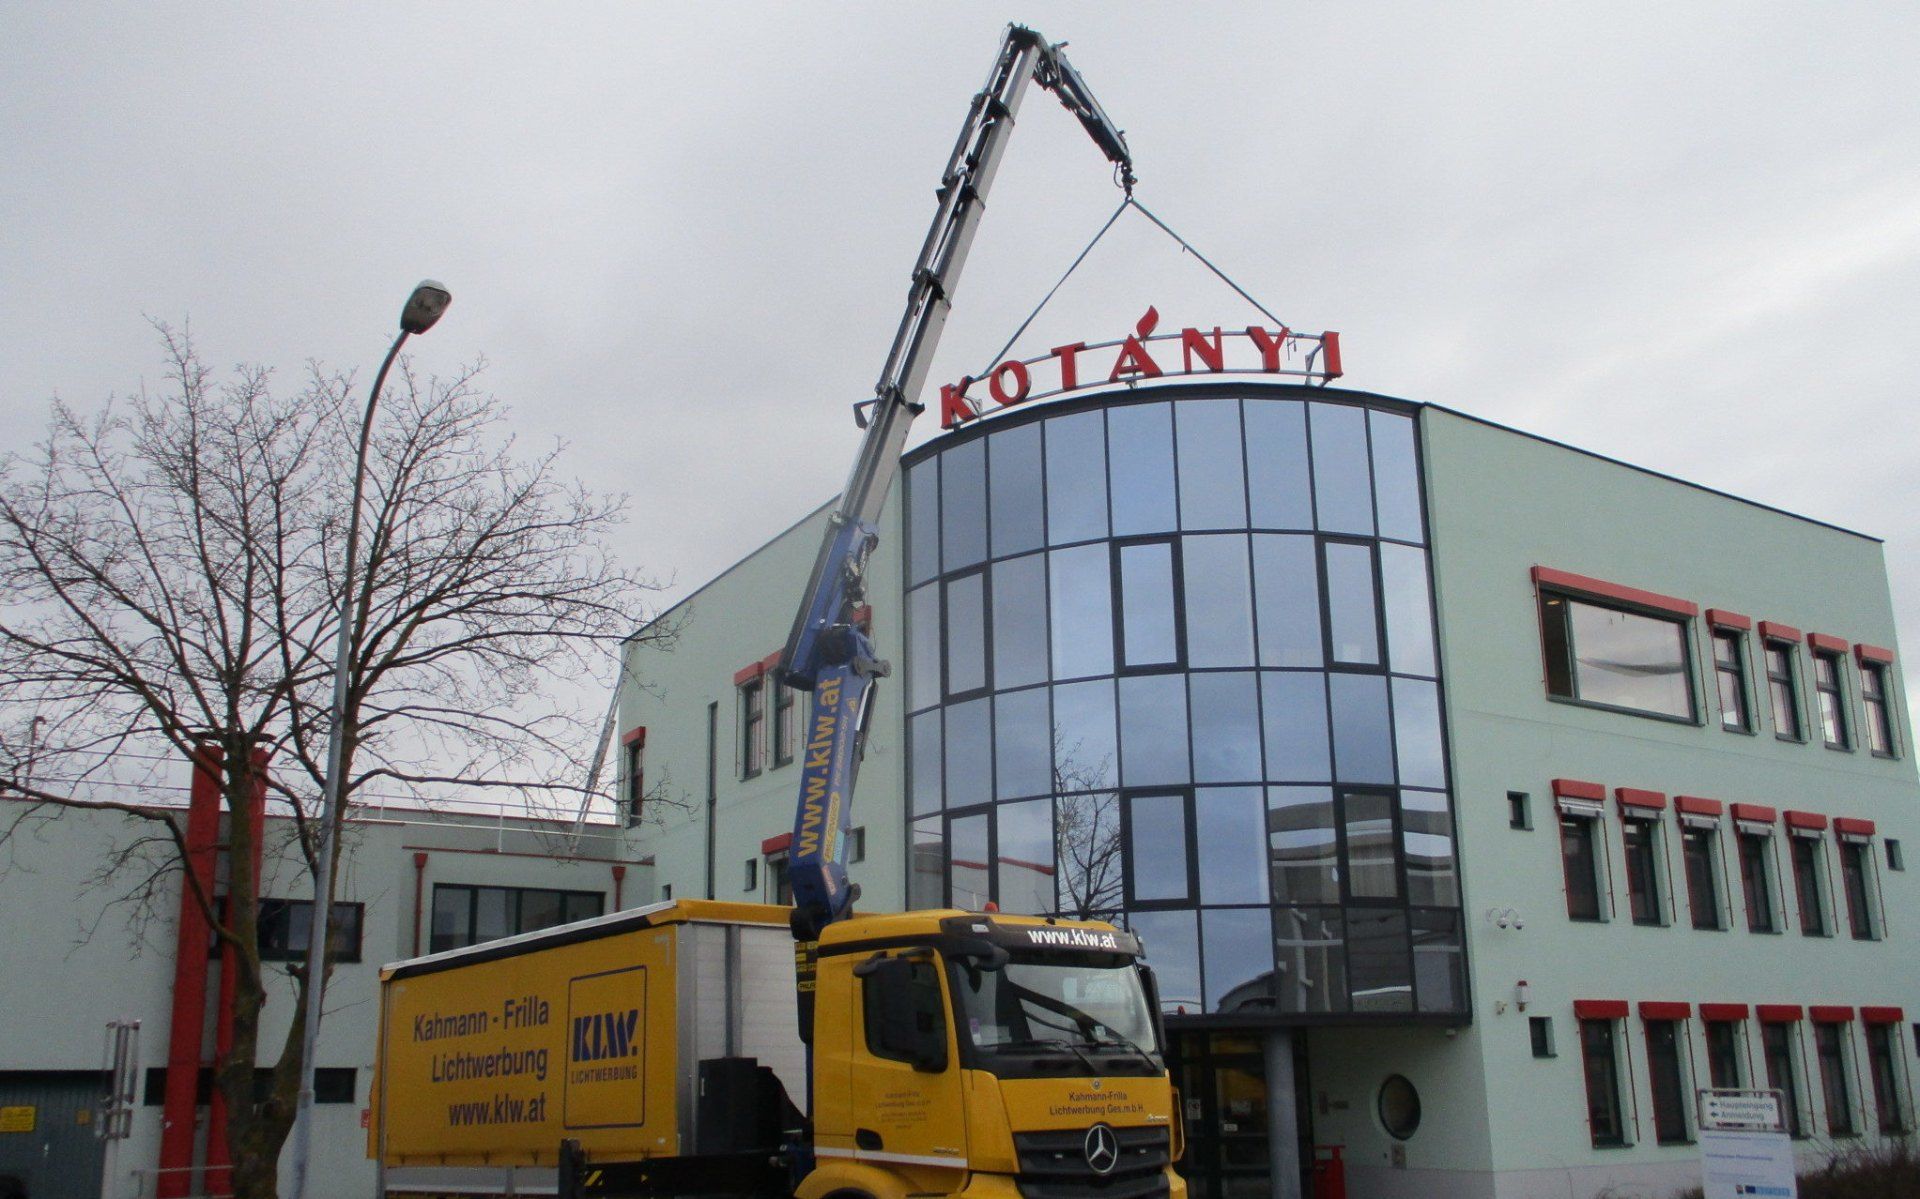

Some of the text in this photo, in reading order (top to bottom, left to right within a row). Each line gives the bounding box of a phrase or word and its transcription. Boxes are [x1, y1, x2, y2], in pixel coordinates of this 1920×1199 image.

[940, 305, 1343, 429] KOTÁNYI
[798, 677, 843, 858] www.klw.at
[1027, 928, 1117, 949] www.klw.at
[414, 1011, 488, 1042] Kahmann
[504, 995, 549, 1030] Frilla
[432, 1046, 549, 1083] Lichtwerbung
[571, 1064, 638, 1085] LICHTWERBUNG
[449, 1091, 546, 1126] www.klw.at
[1050, 1105, 1106, 1116] Lichtwerbung
